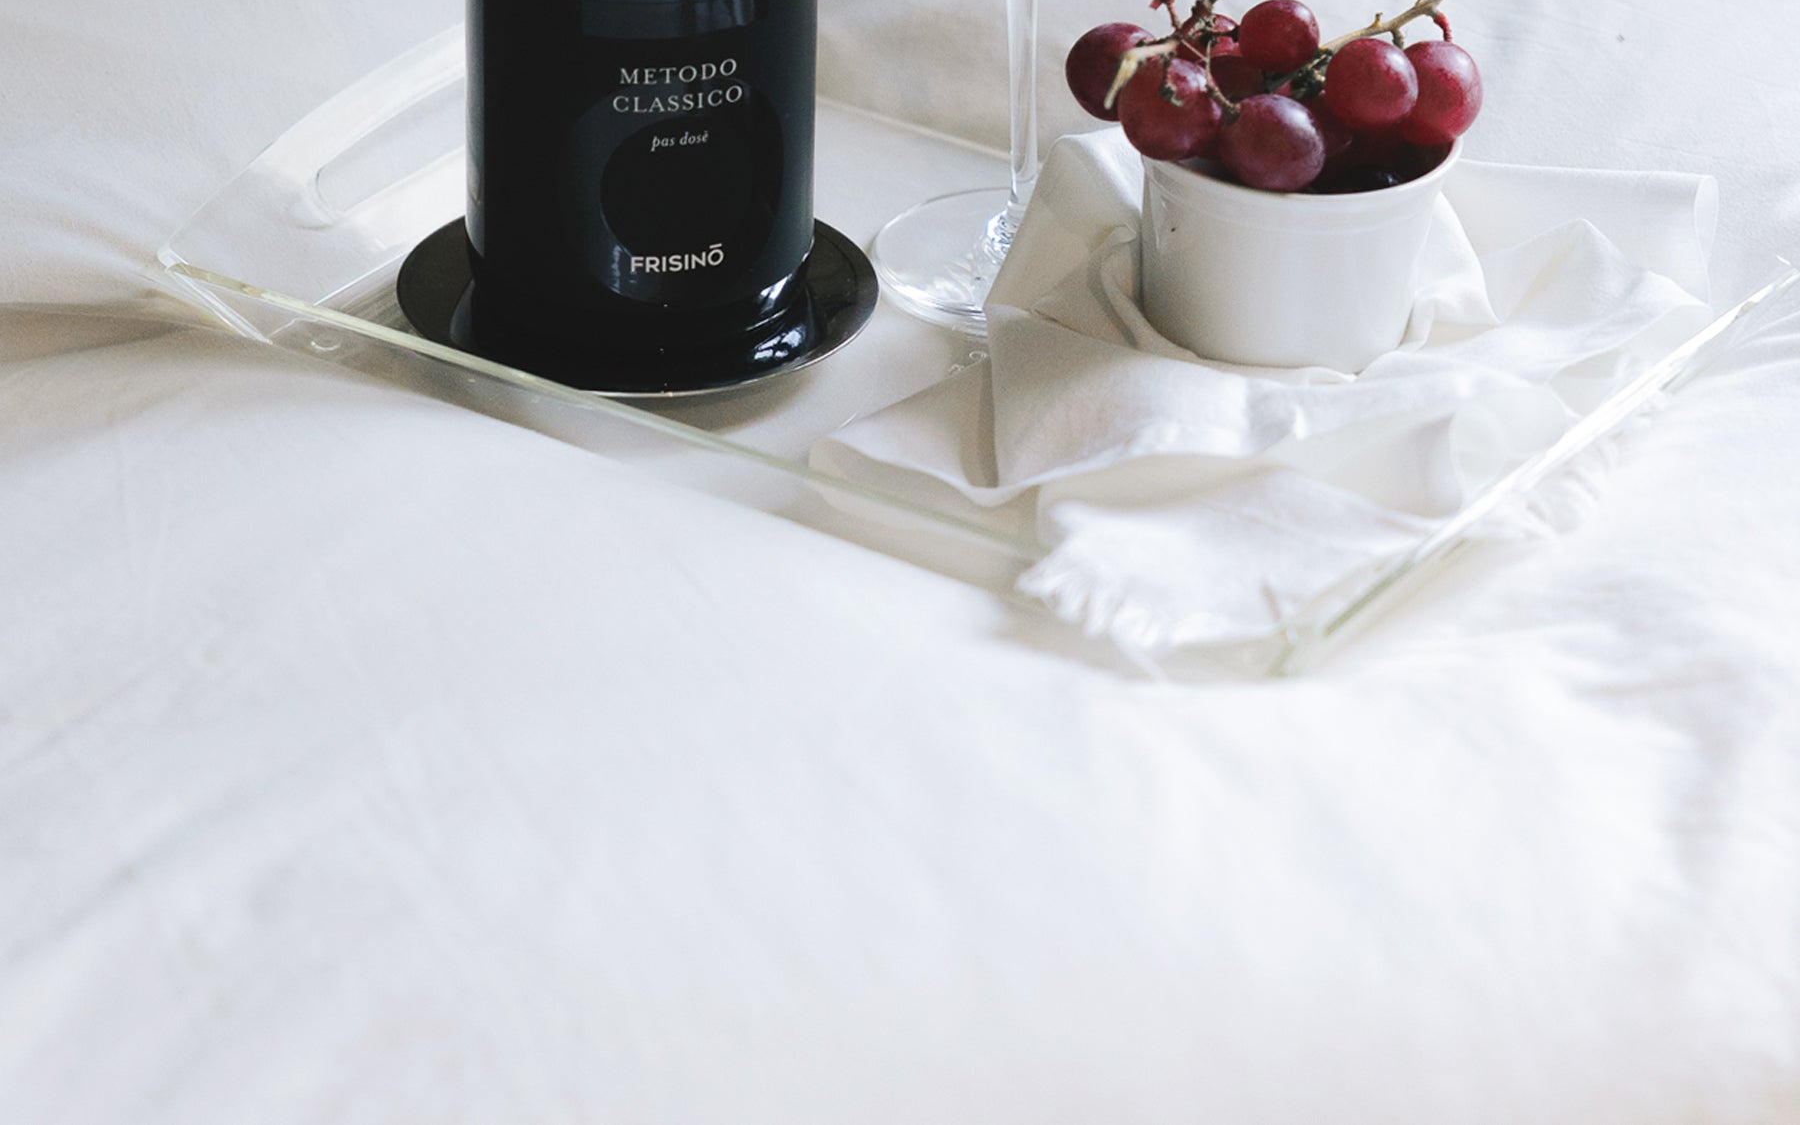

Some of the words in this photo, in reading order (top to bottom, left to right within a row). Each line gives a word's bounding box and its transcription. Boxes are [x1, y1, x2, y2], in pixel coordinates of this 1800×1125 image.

[620, 58, 737, 84] METODO
[612, 85, 743, 113] CLASSICO
[650, 135, 676, 152] pas
